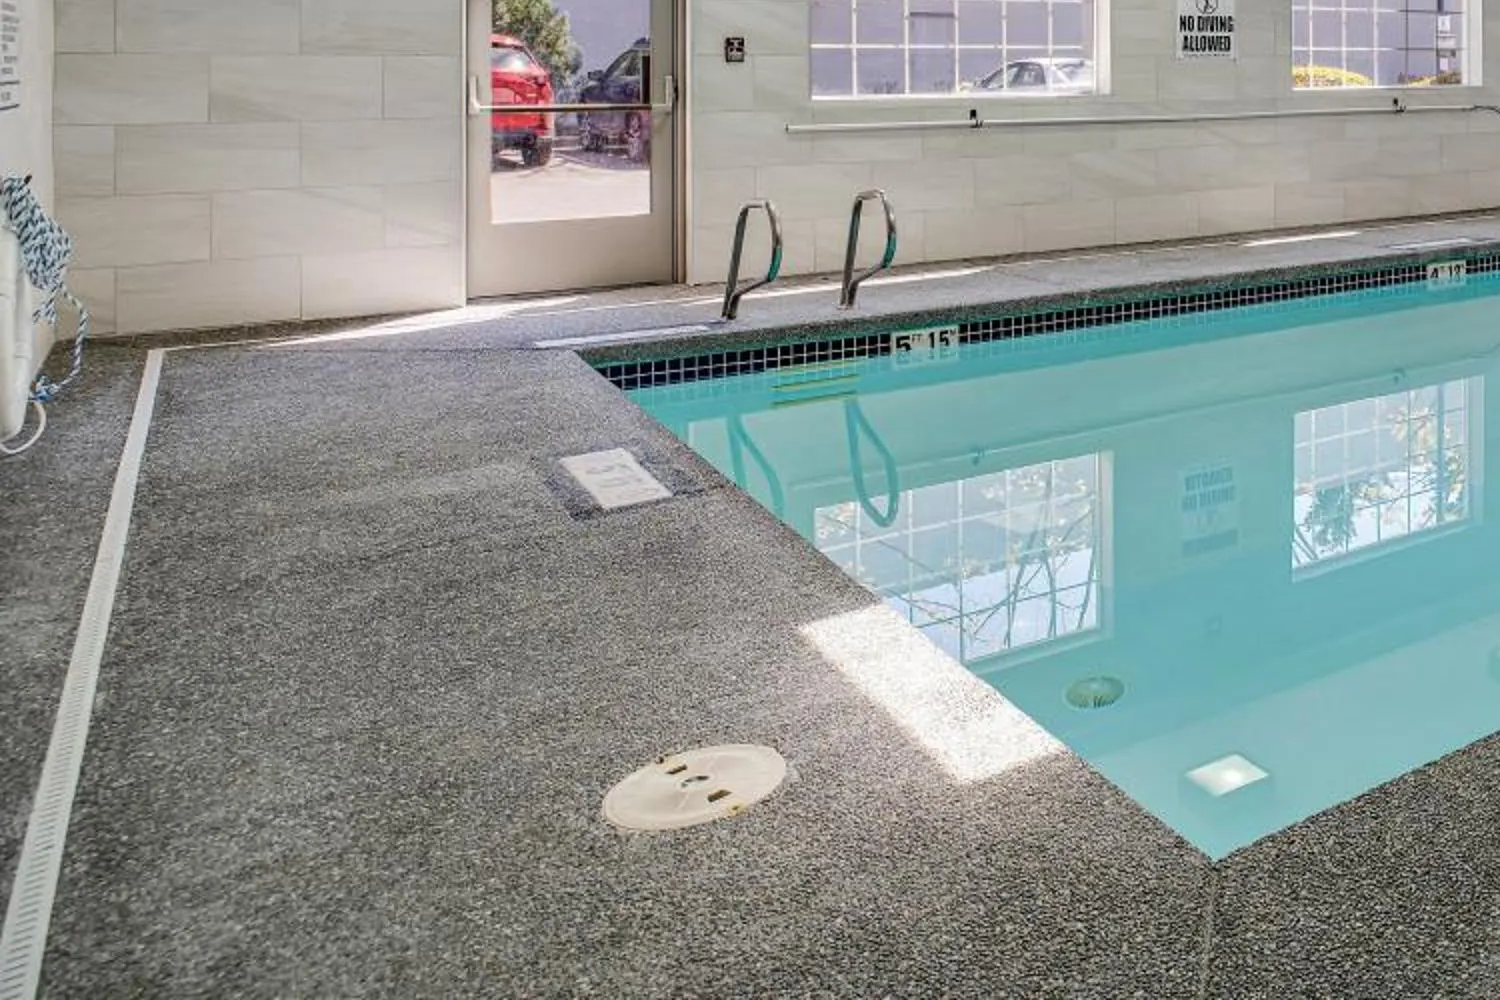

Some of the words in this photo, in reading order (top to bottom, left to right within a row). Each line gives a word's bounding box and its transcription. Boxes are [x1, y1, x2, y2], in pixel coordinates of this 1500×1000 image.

[1179, 15, 1195, 32] NO
[1197, 15, 1235, 33] DIVING
[1182, 35, 1231, 52] ALLOWED
